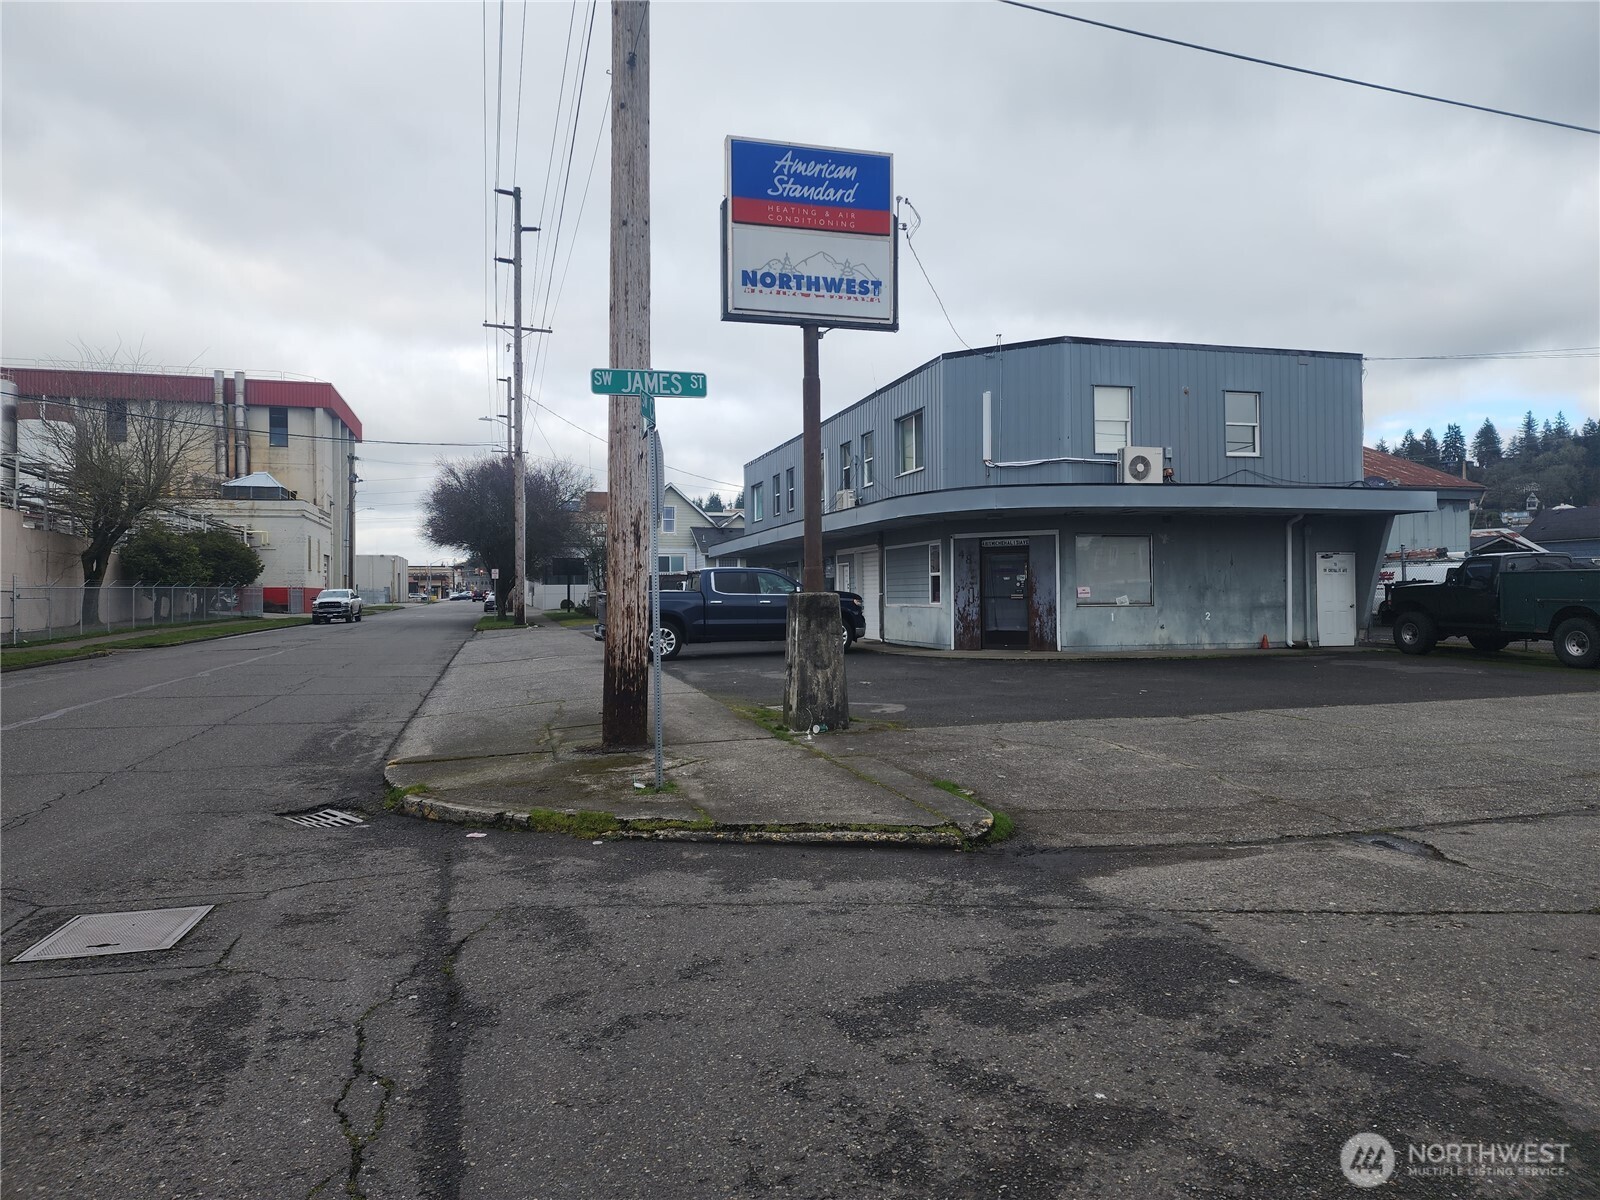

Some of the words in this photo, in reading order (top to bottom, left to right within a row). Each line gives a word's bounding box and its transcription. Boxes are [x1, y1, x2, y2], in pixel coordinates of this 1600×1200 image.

[773, 150, 858, 181] American
[767, 175, 860, 203] Standard
[767, 205, 817, 217] HEATING
[825, 210, 830, 218] &
[838, 211, 856, 220] AIR
[767, 214, 856, 229] CONDITIONING
[741, 269, 882, 297] NORTHWEST
[594, 371, 612, 386] SW
[621, 372, 683, 395] JAMES
[690, 375, 704, 389] ST
[1205, 611, 1211, 620] 2
